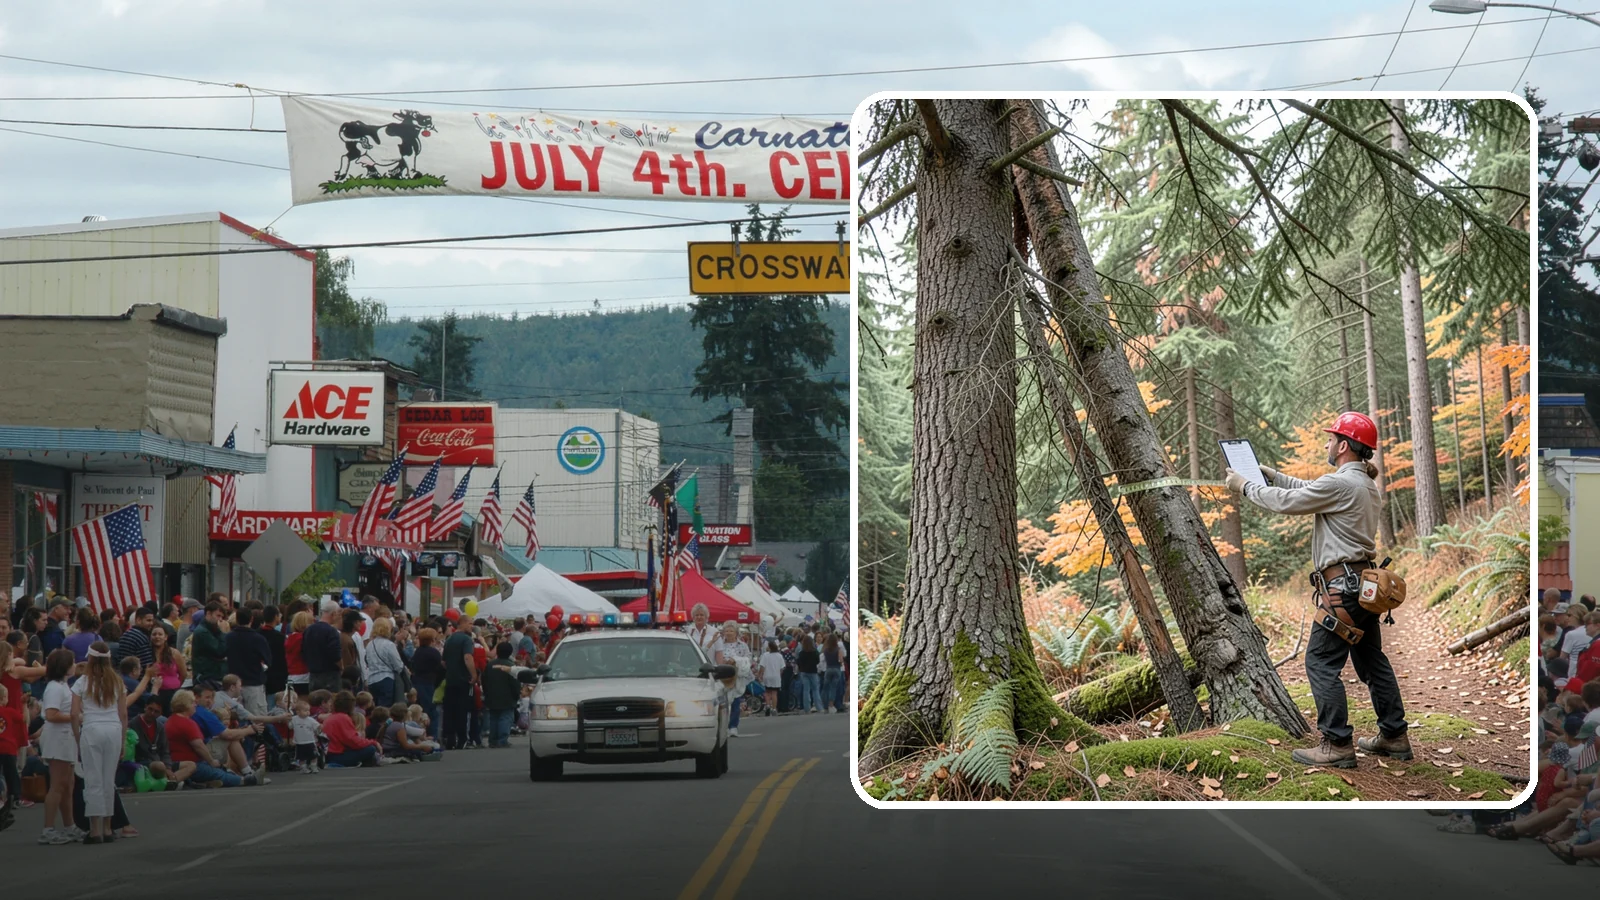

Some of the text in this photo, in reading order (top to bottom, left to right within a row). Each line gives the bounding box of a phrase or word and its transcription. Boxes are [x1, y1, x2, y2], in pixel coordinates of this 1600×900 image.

[695, 121, 850, 150] Carnat
[481, 141, 605, 193] JULY
[632, 150, 746, 198] 4th.
[697, 254, 850, 280] CROSSWA
[282, 380, 374, 420] ACE
[406, 409, 452, 422] CEDAR
[283, 421, 371, 437] Hardware
[416, 428, 477, 447] Coca-Cola
[83, 485, 155, 495] St. Vincent de Paul
[688, 526, 741, 535] CRNATION
[699, 535, 730, 543] GLASS
